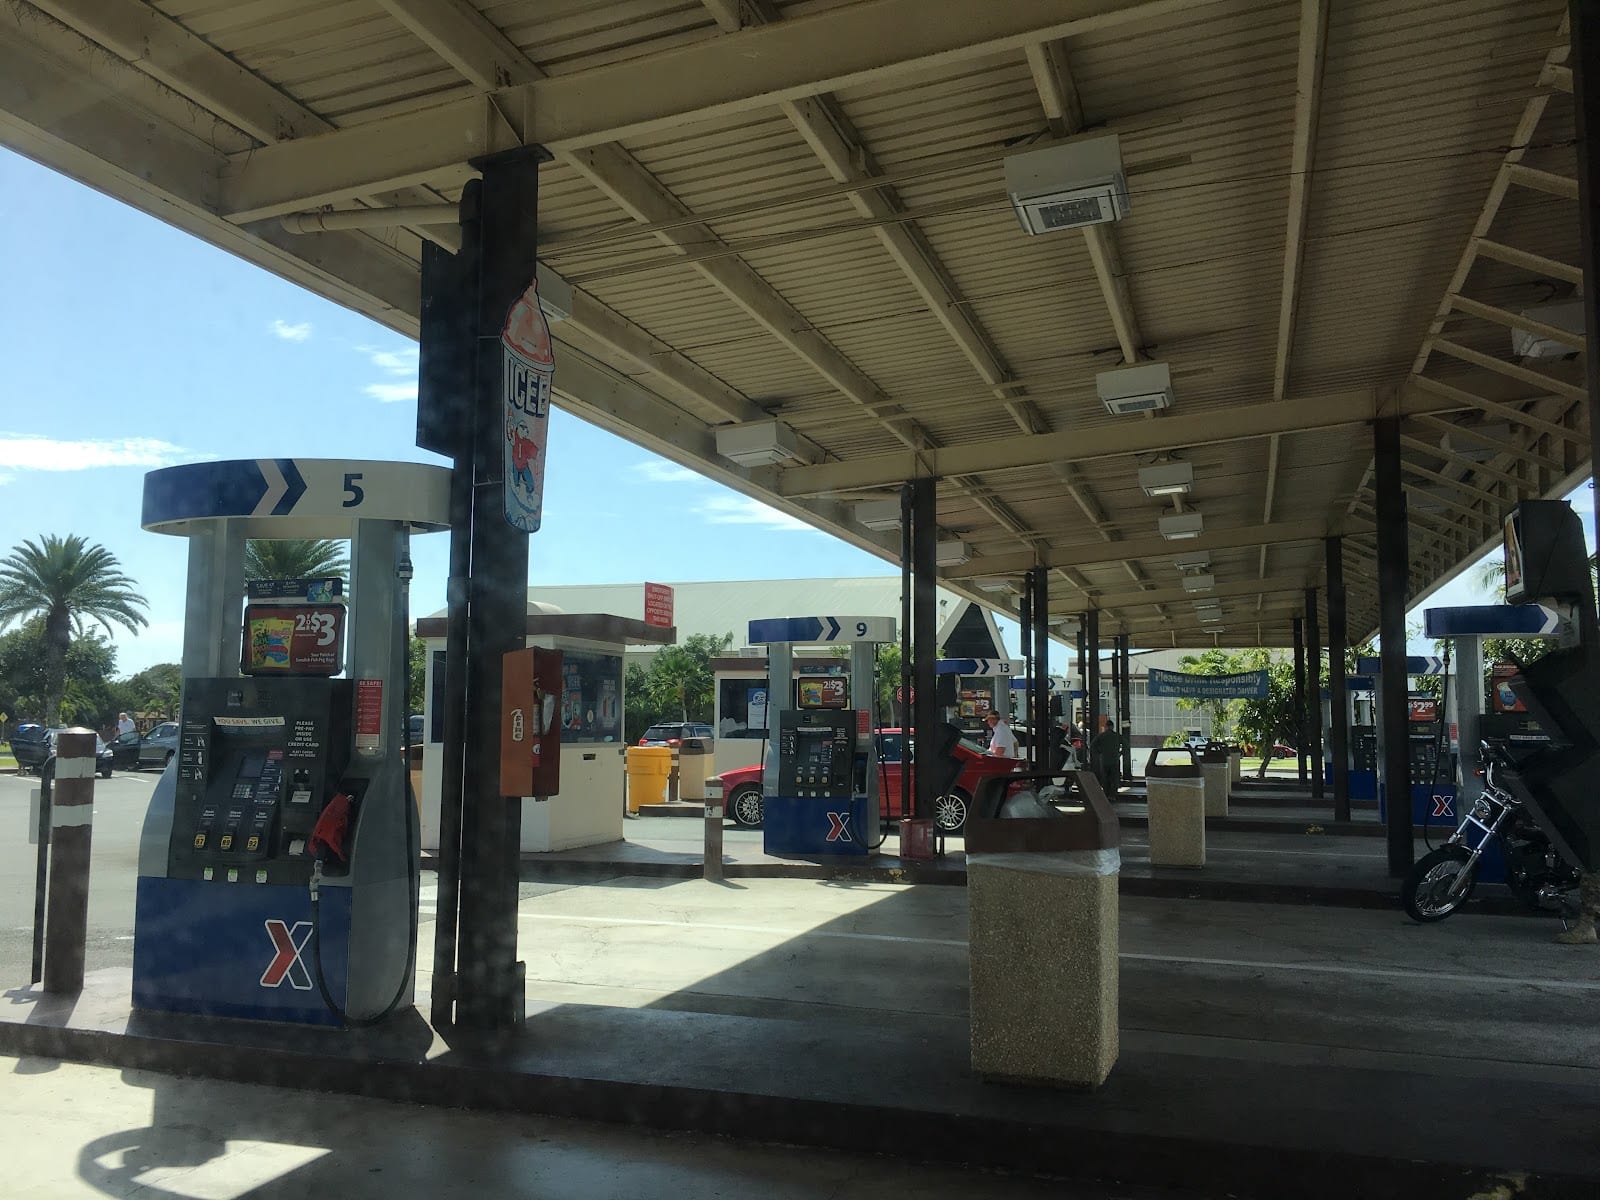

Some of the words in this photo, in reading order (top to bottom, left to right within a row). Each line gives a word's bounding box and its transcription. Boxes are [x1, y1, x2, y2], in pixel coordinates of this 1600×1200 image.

[508, 358, 549, 418] ICEE
[342, 473, 365, 508] 5
[296, 614, 306, 630] 2
[311, 611, 336, 646] $3
[856, 622, 868, 636] 9
[998, 663, 1010, 672] 13
[1155, 672, 1183, 683] Please
[831, 680, 844, 696] $3
[1432, 795, 1454, 816] X
[826, 812, 852, 842] X
[260, 919, 314, 990] X
